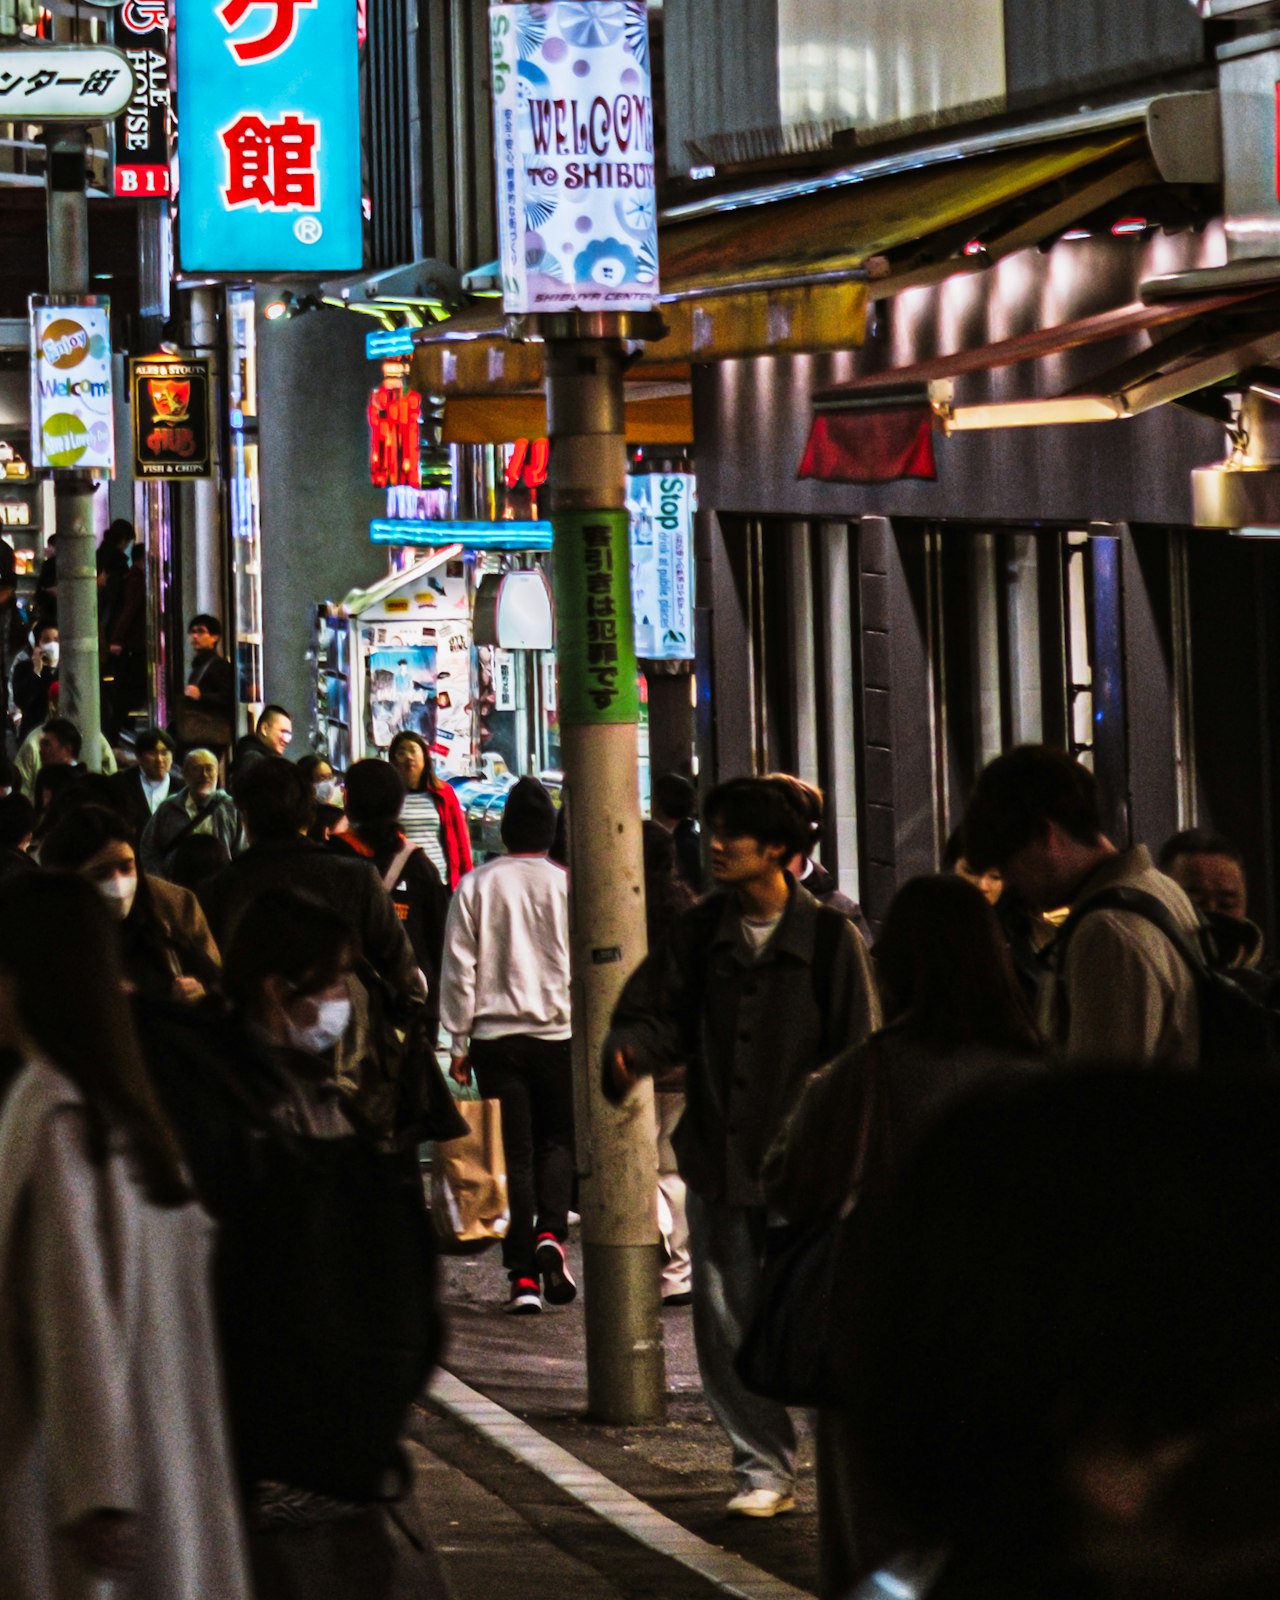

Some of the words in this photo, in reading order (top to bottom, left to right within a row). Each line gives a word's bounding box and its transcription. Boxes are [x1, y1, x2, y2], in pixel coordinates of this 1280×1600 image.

[491, 14, 512, 95] Safe
[124, 49, 151, 152] HOUSE
[148, 50, 170, 108] ALE
[527, 166, 559, 189] TO
[42, 329, 88, 364] Enjoy
[146, 427, 197, 458] HUB
[143, 465, 164, 473] FISH
[175, 464, 205, 474] CHIPS
[654, 476, 685, 530] Stop
